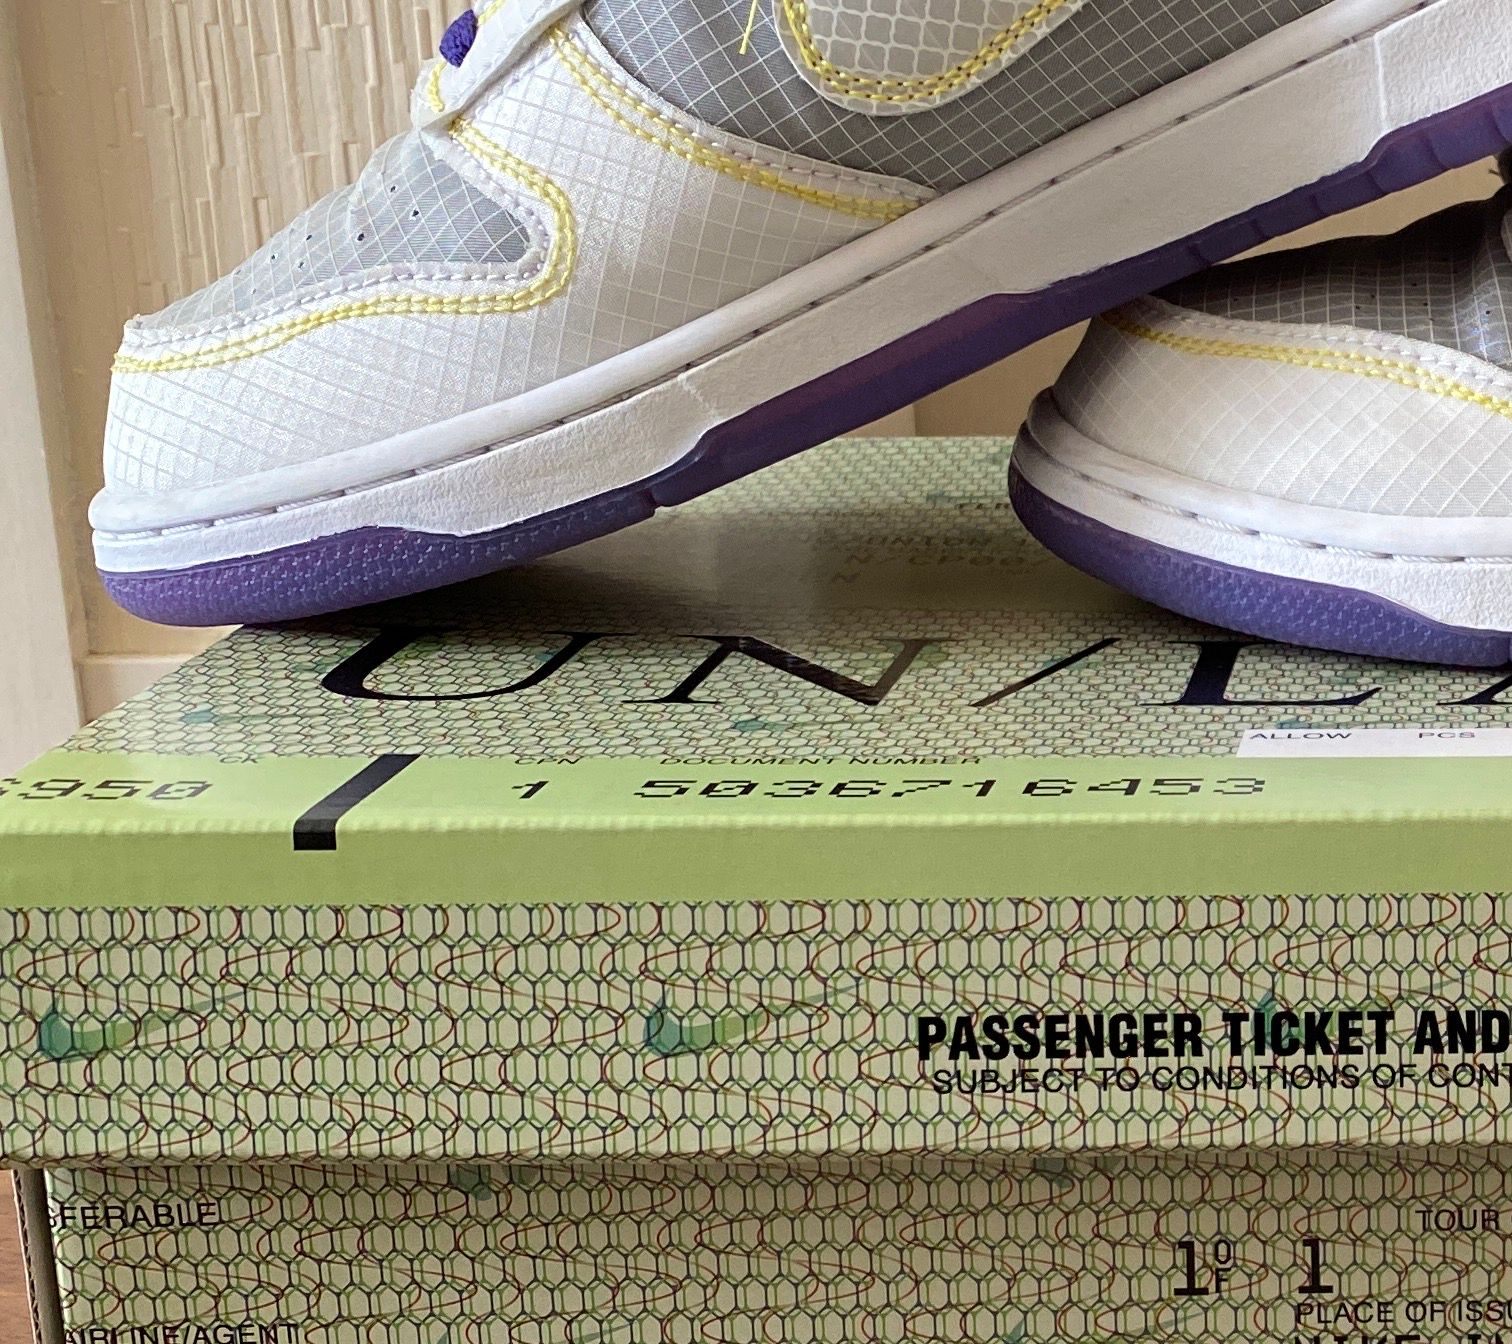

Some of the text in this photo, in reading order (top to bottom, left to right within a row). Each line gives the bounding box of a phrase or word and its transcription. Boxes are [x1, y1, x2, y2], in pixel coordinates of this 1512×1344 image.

[1249, 731, 1353, 740] ALLOW
[1418, 731, 1476, 739] PCS
[219, 756, 259, 764] CK
[513, 757, 981, 766] CPN DOCUMENT NUMBER
[511, 780, 550, 800] 1
[917, 1013, 1204, 1061] PASSENGER
[1222, 1010, 1395, 1058] TICKET
[1413, 1009, 1510, 1055] AND
[933, 1066, 1083, 1095] SUBJECT
[1099, 1066, 1142, 1093] TO
[1150, 1063, 1361, 1092] CONDITIONS
[1372, 1064, 1419, 1089] OF
[1414, 1209, 1501, 1232] TOUR
[1298, 1237, 1334, 1295] 1
[1297, 1301, 1394, 1325] PLACE
[1404, 1301, 1448, 1323] OF
